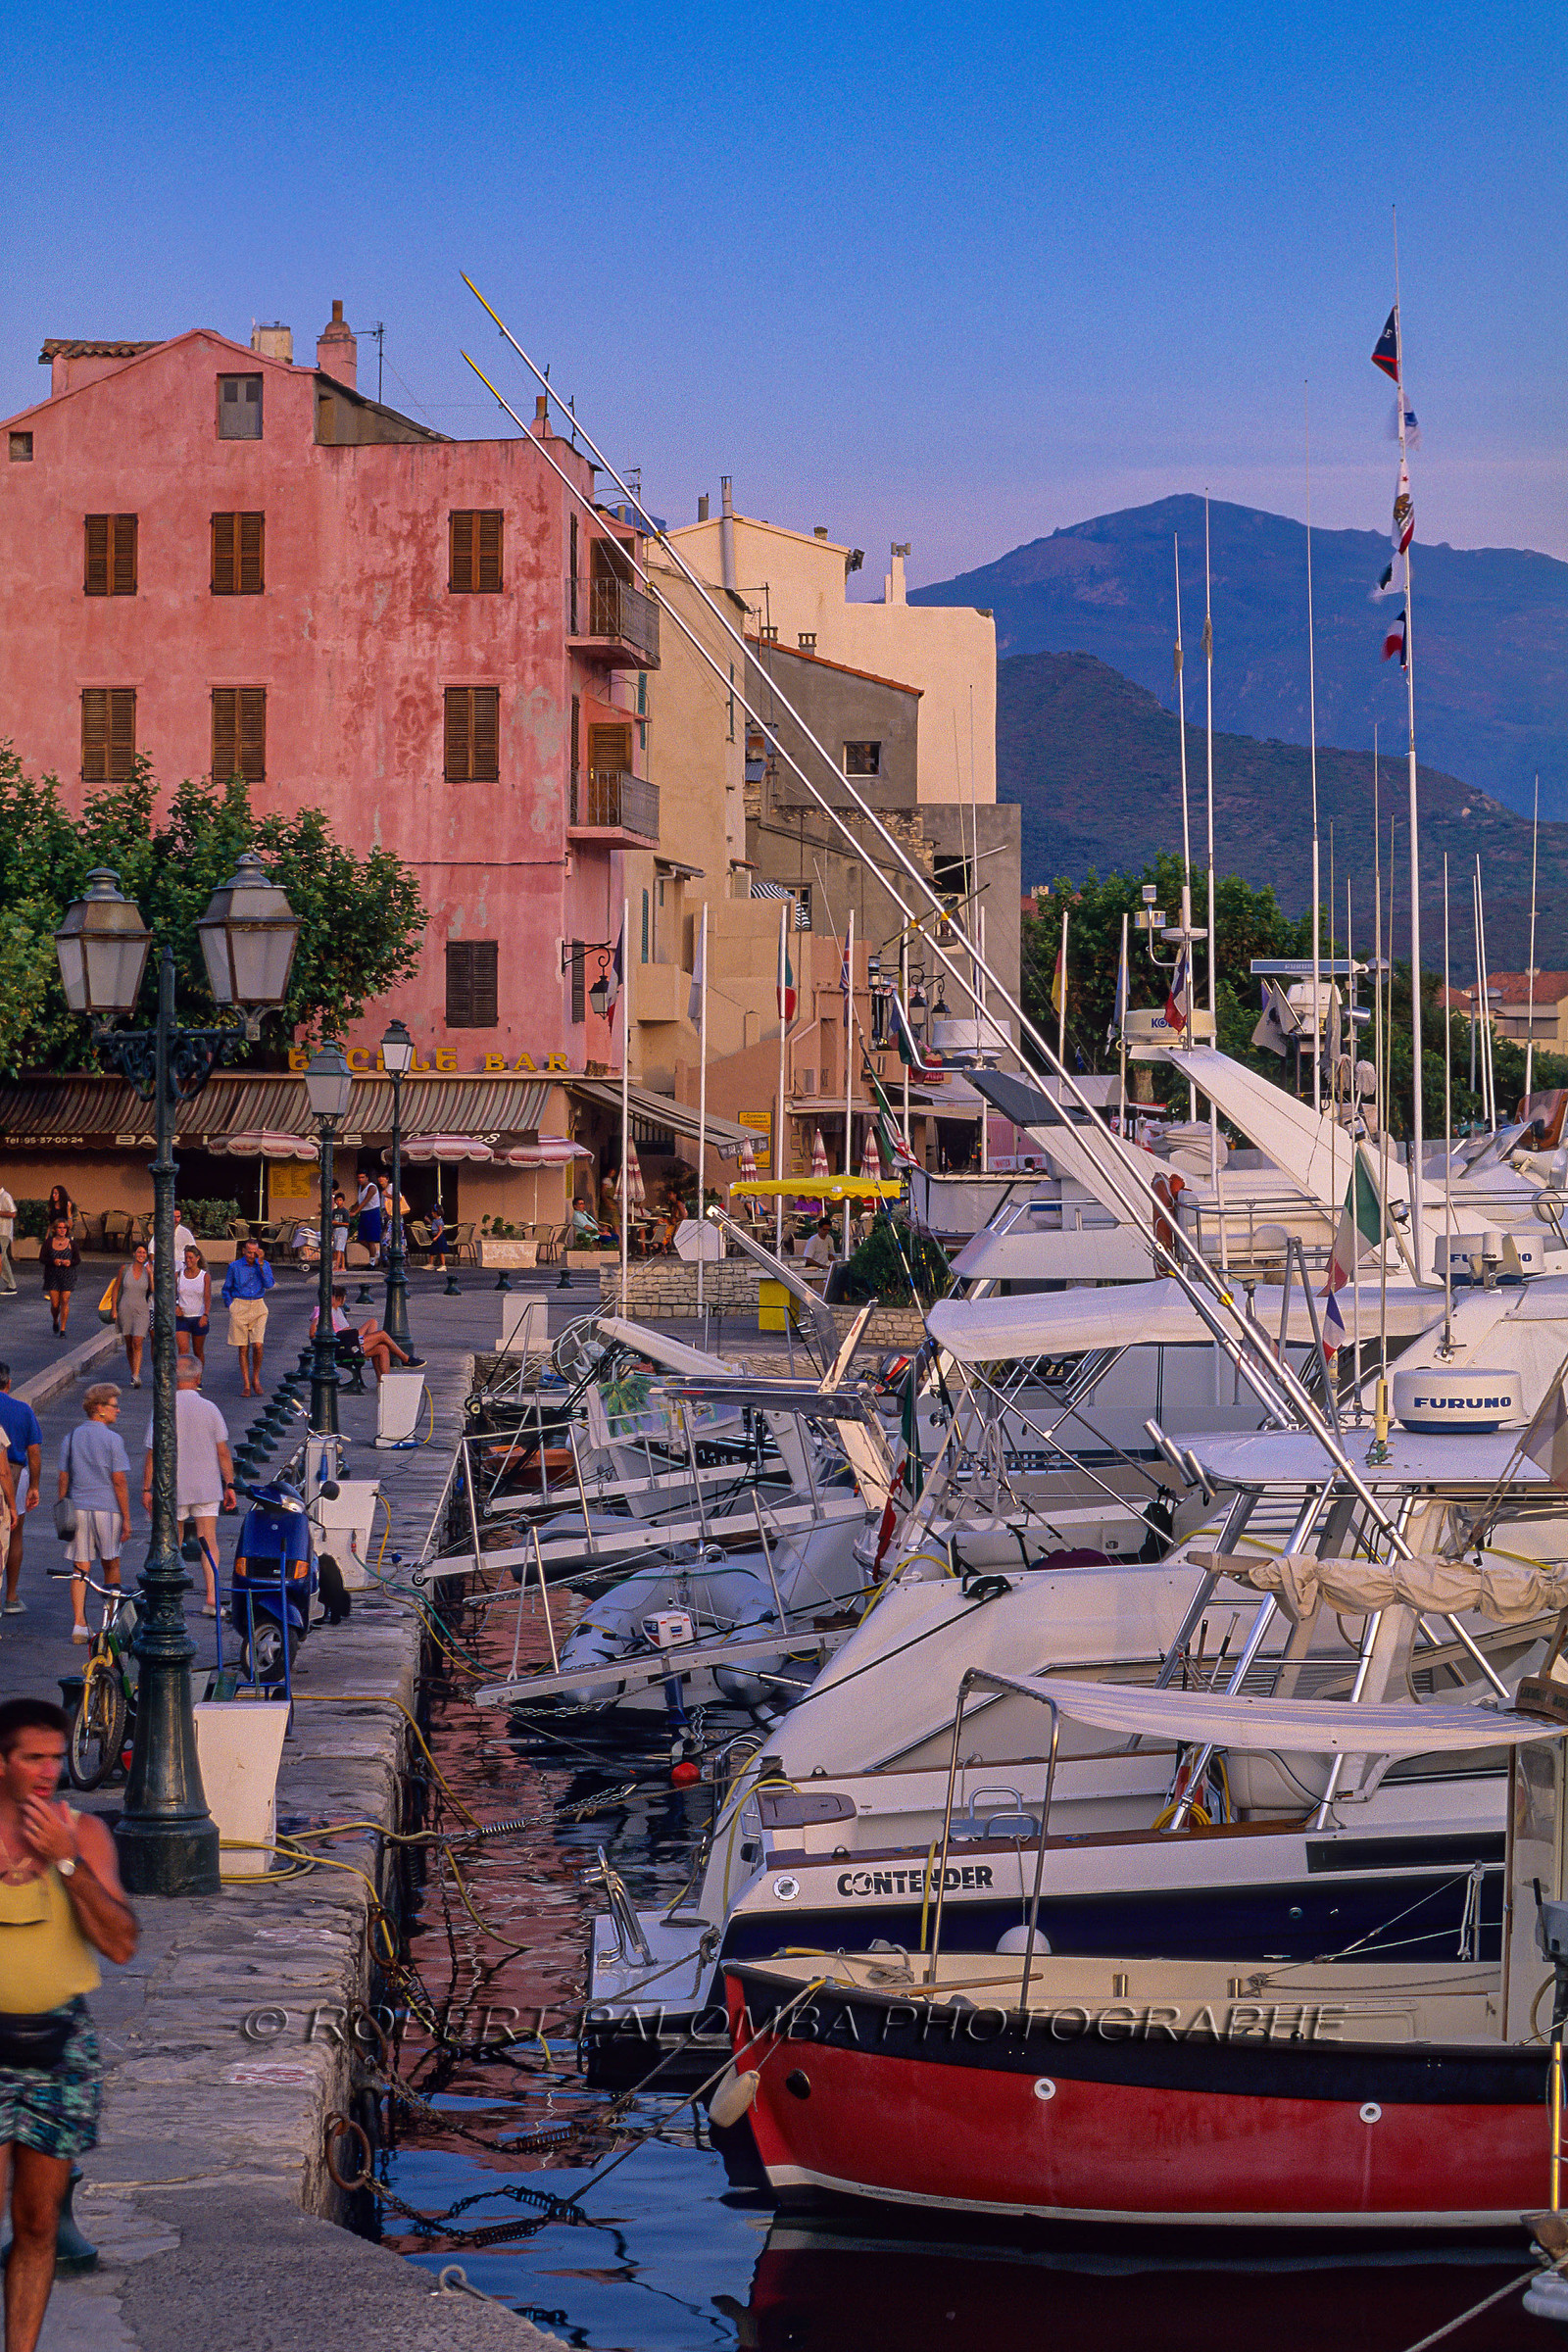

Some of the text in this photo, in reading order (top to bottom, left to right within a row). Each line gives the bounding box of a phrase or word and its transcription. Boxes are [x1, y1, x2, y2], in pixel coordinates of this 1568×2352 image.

[288, 1048, 569, 1071] ECLE BAR
[1413, 1396, 1512, 1409] FURUNO
[836, 1865, 994, 1897] CONTENDER
